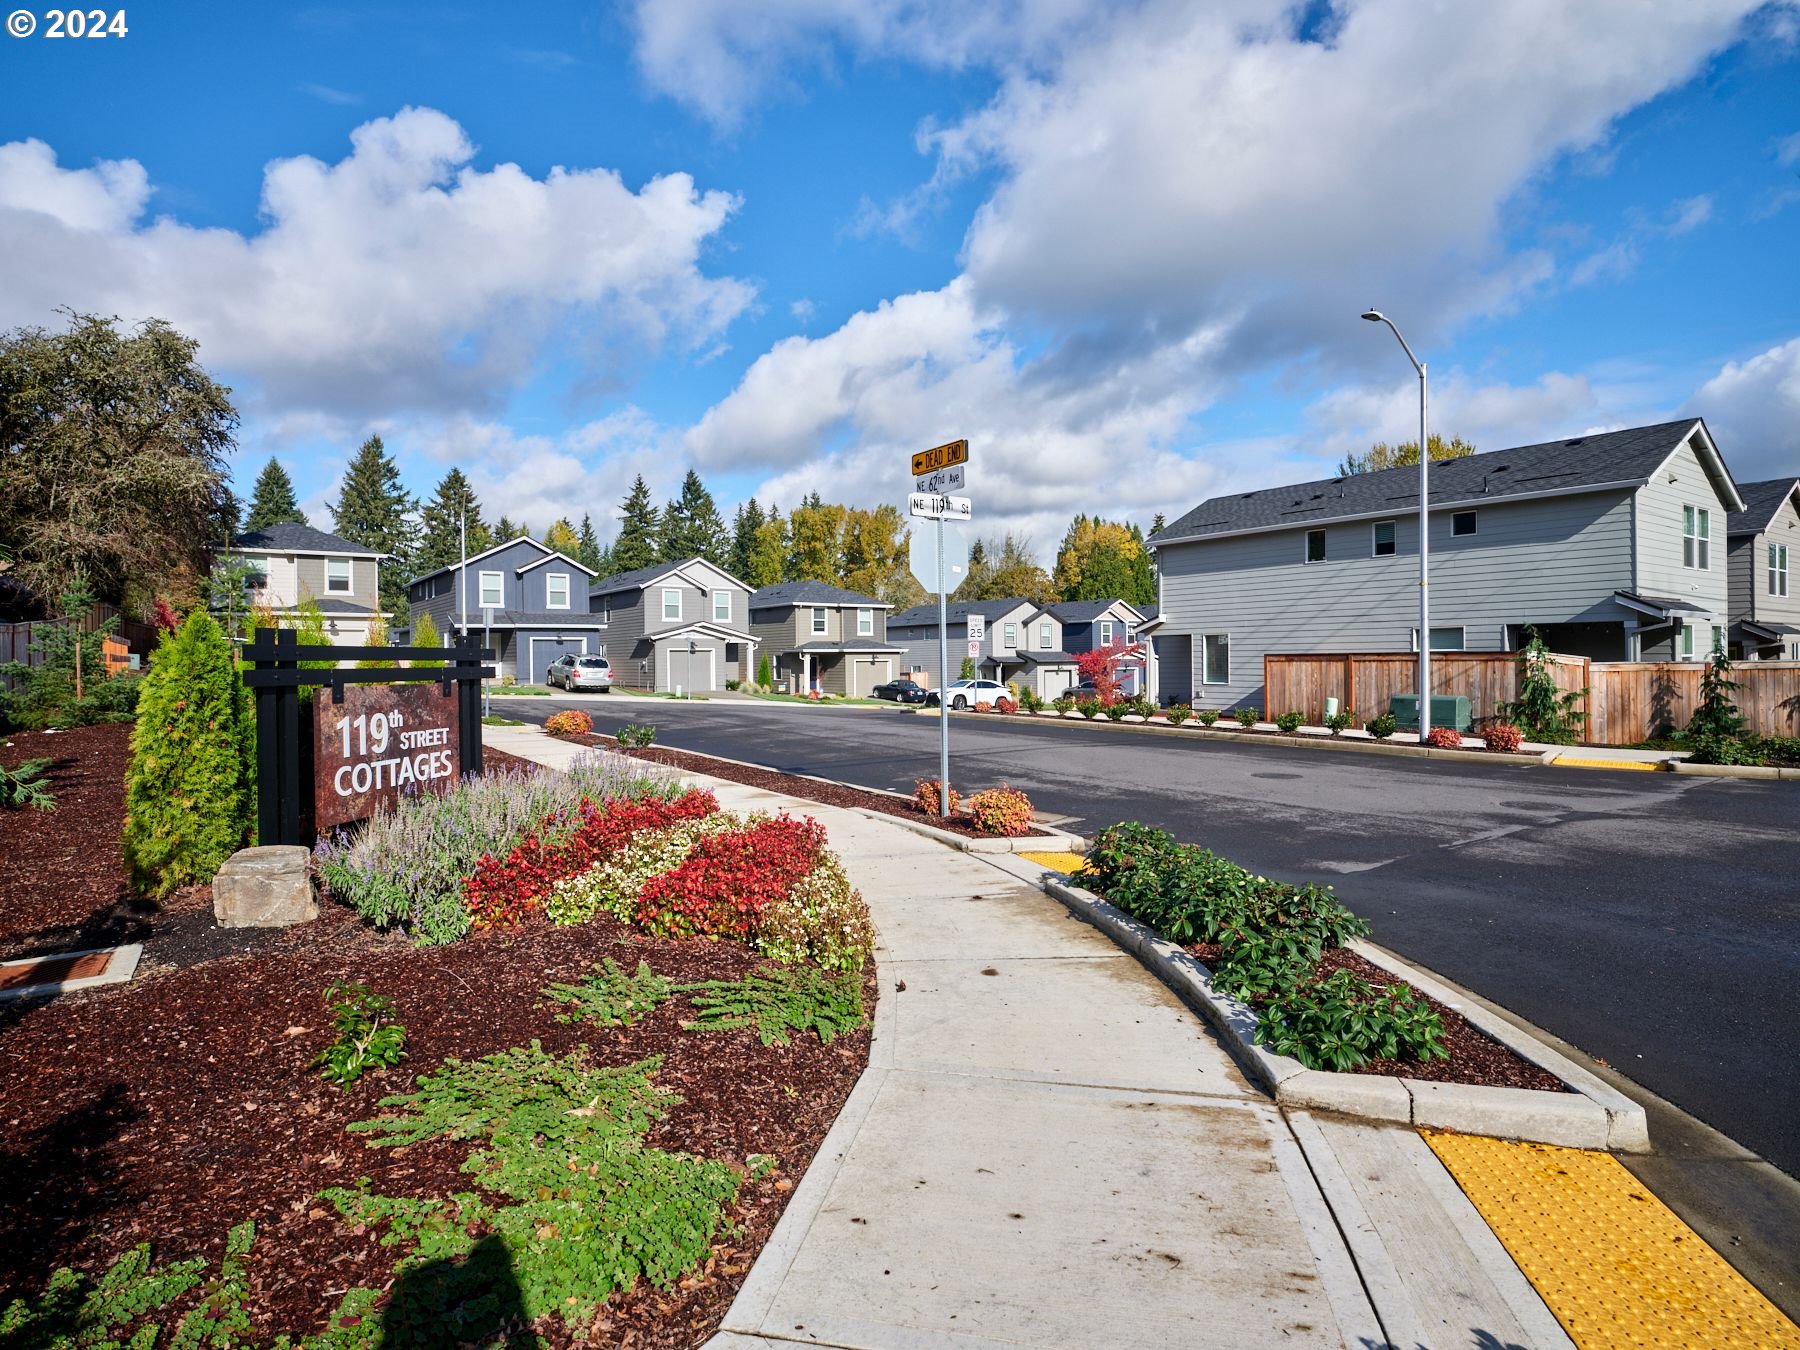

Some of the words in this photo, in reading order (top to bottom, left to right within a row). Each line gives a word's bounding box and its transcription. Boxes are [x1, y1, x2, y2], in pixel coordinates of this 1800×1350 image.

[925, 449, 943, 469] DEAD
[947, 444, 961, 462] END
[917, 481, 925, 492] NE
[928, 473, 945, 492] 62nd
[949, 473, 960, 485] Ave
[913, 498, 924, 510] NE
[932, 497, 953, 514] 119th
[961, 503, 969, 515] St
[970, 628, 983, 638] 25
[336, 709, 404, 759] 119th
[400, 727, 450, 750] STREET
[334, 749, 453, 797] COTTAGES
